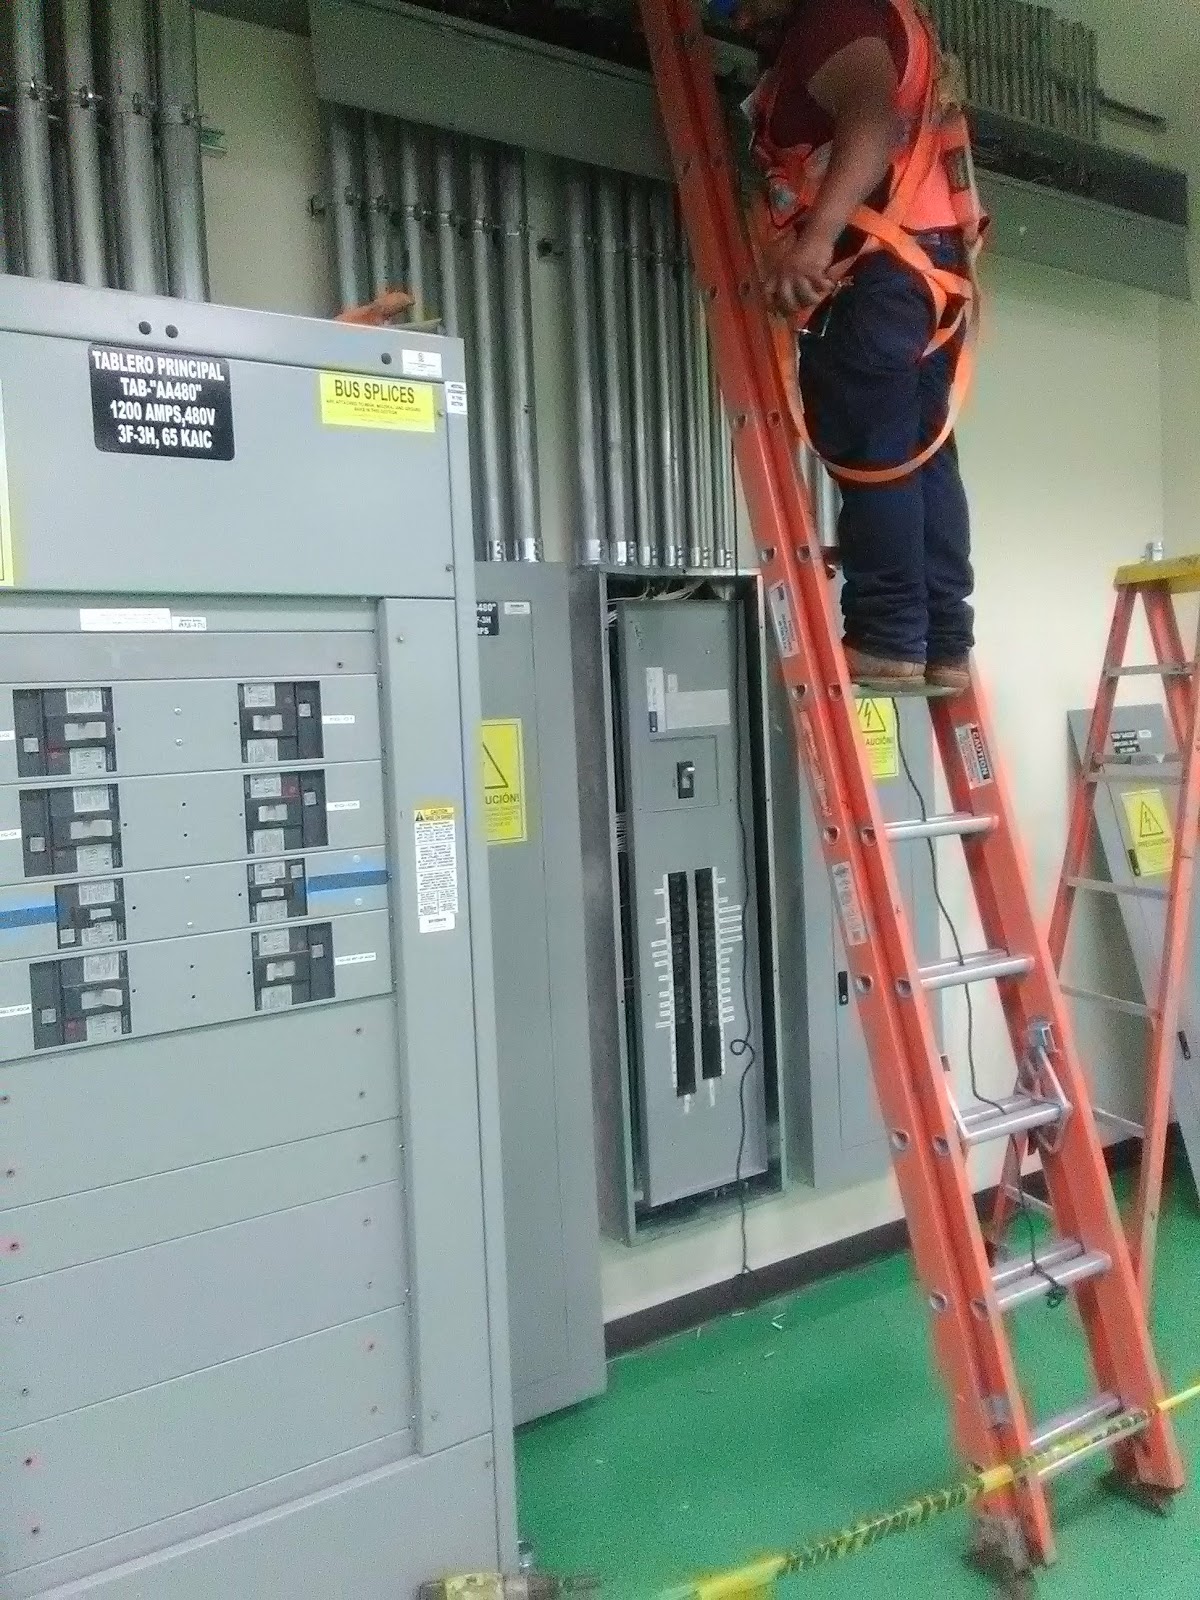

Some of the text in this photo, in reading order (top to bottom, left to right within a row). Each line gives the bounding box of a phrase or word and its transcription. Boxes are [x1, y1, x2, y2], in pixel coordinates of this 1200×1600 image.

[92, 350, 225, 381] TABLERO PRINCIPAL
[120, 377, 202, 401] TAB-"AA480"
[334, 379, 415, 404] BUS SPLICES
[110, 402, 216, 427] 1200 AMPS,480V
[117, 425, 213, 449] 3F-3H, 65 KAIC
[971, 731, 989, 775] CAUTION
